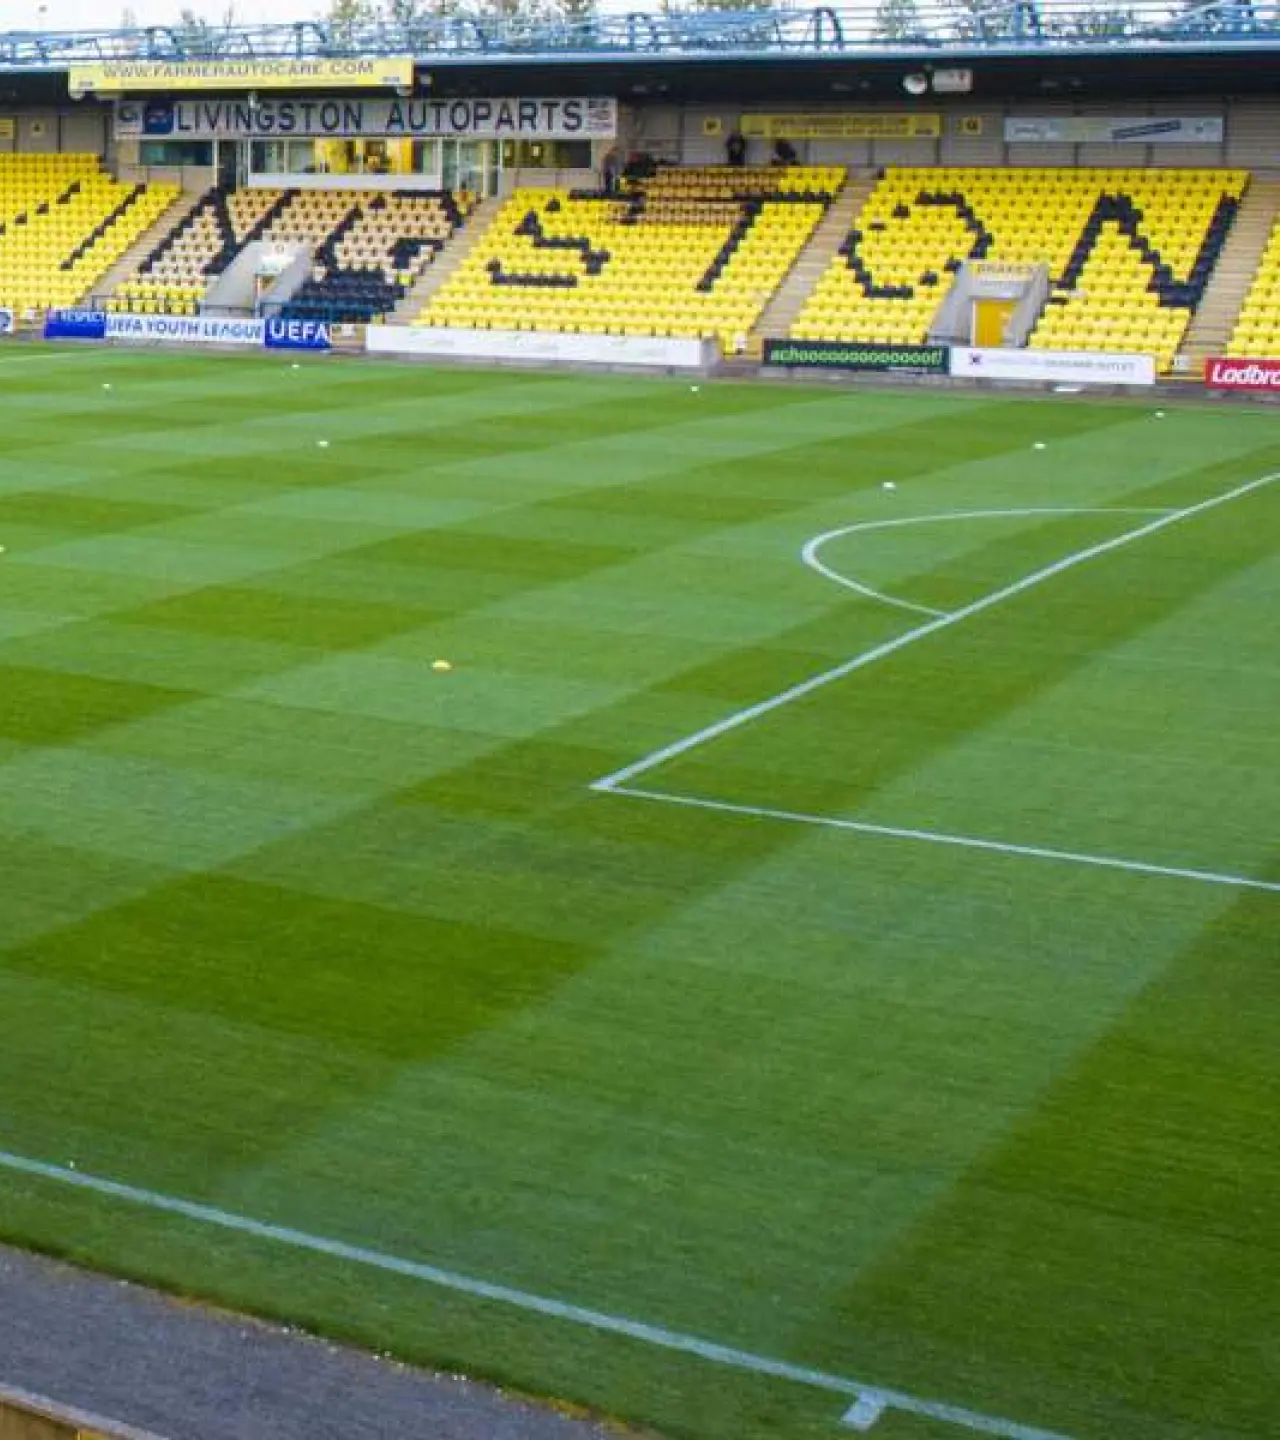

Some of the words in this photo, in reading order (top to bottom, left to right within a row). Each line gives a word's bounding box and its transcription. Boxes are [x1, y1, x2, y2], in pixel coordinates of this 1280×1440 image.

[175, 101, 363, 133] LIVINGSTON
[386, 101, 584, 133] AUTOPARTS
[106, 318, 143, 333] UEFA
[146, 320, 199, 336] YOUTH
[203, 321, 263, 340] LEAGUE
[268, 319, 331, 343] UEFA
